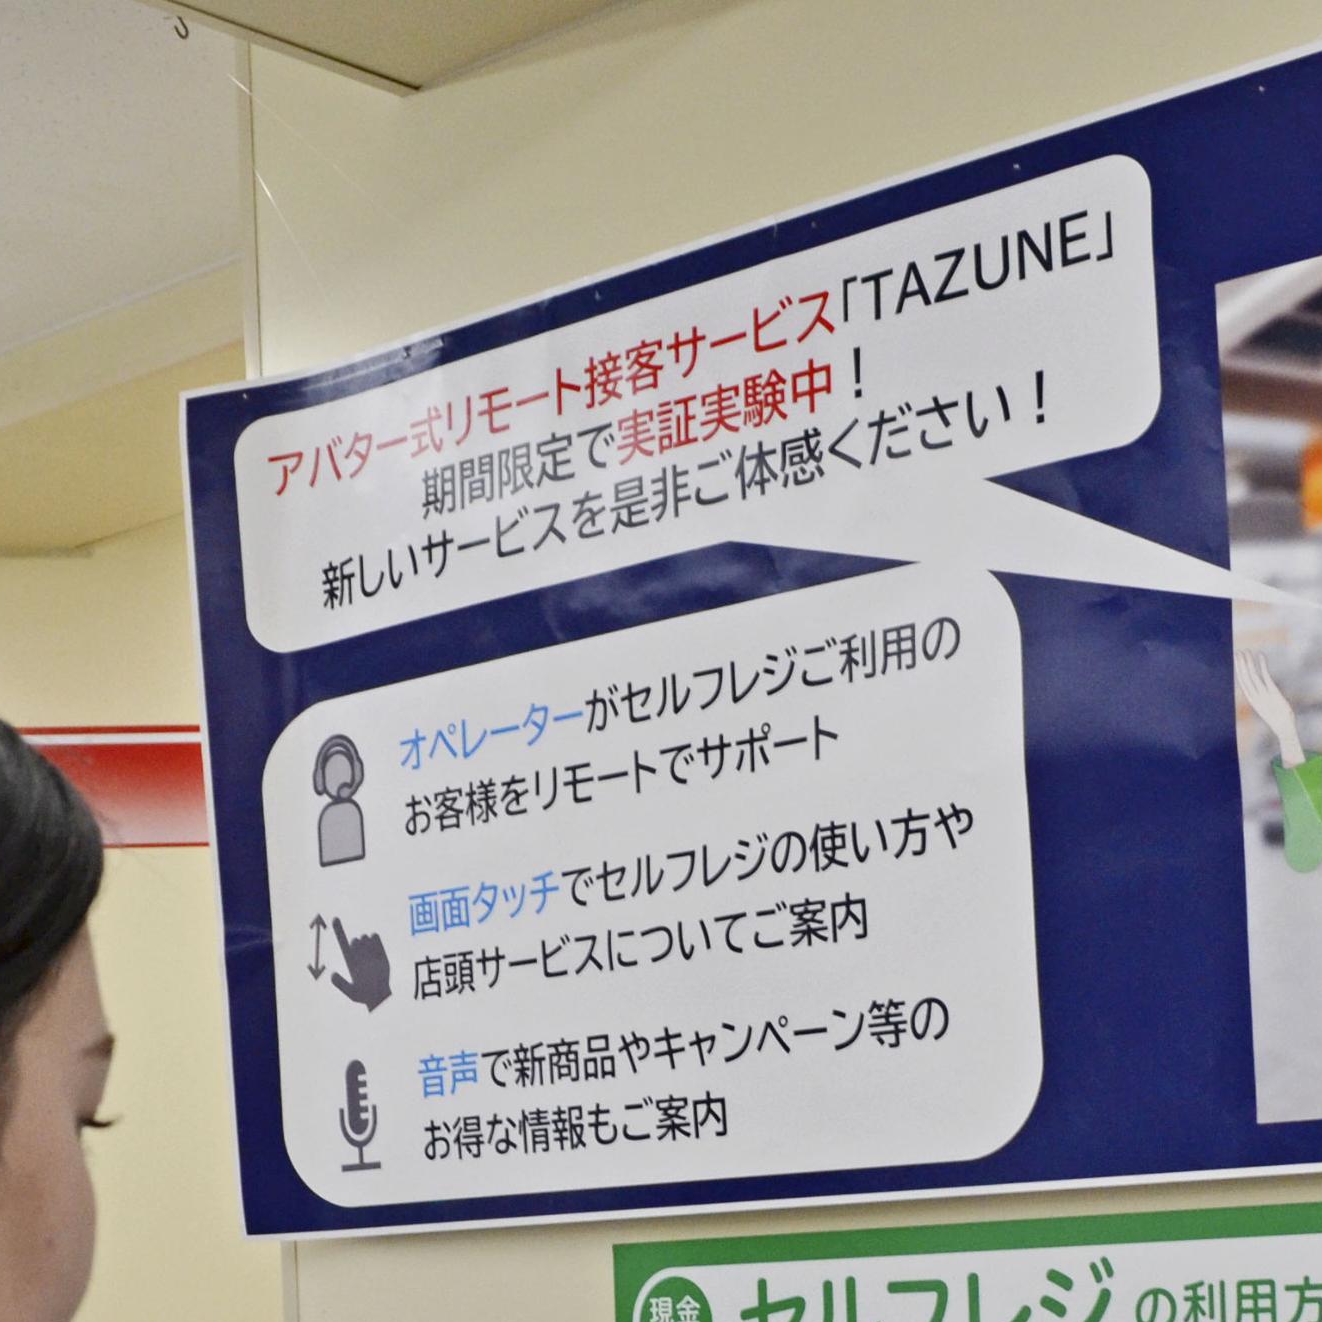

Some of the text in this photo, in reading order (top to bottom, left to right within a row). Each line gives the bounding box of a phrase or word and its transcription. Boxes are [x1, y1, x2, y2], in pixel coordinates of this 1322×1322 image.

[268, 208, 1114, 496] アバター式リモート接客サービス「TAZUNE」
[321, 371, 1046, 610] 新しいサービスを是非ご体感ください！
[400, 617, 962, 770] オペレーターがセルフレジご利用の
[404, 716, 841, 836] お客様をリモートでサポート
[409, 803, 974, 935] 画面タッチでセルフレジの使い方や
[413, 894, 869, 1000] 店頭サービスについてご案内
[419, 998, 950, 1098] 音声で新商品やキャンペーン等の
[423, 1092, 729, 1160] お得な情報もご案内
